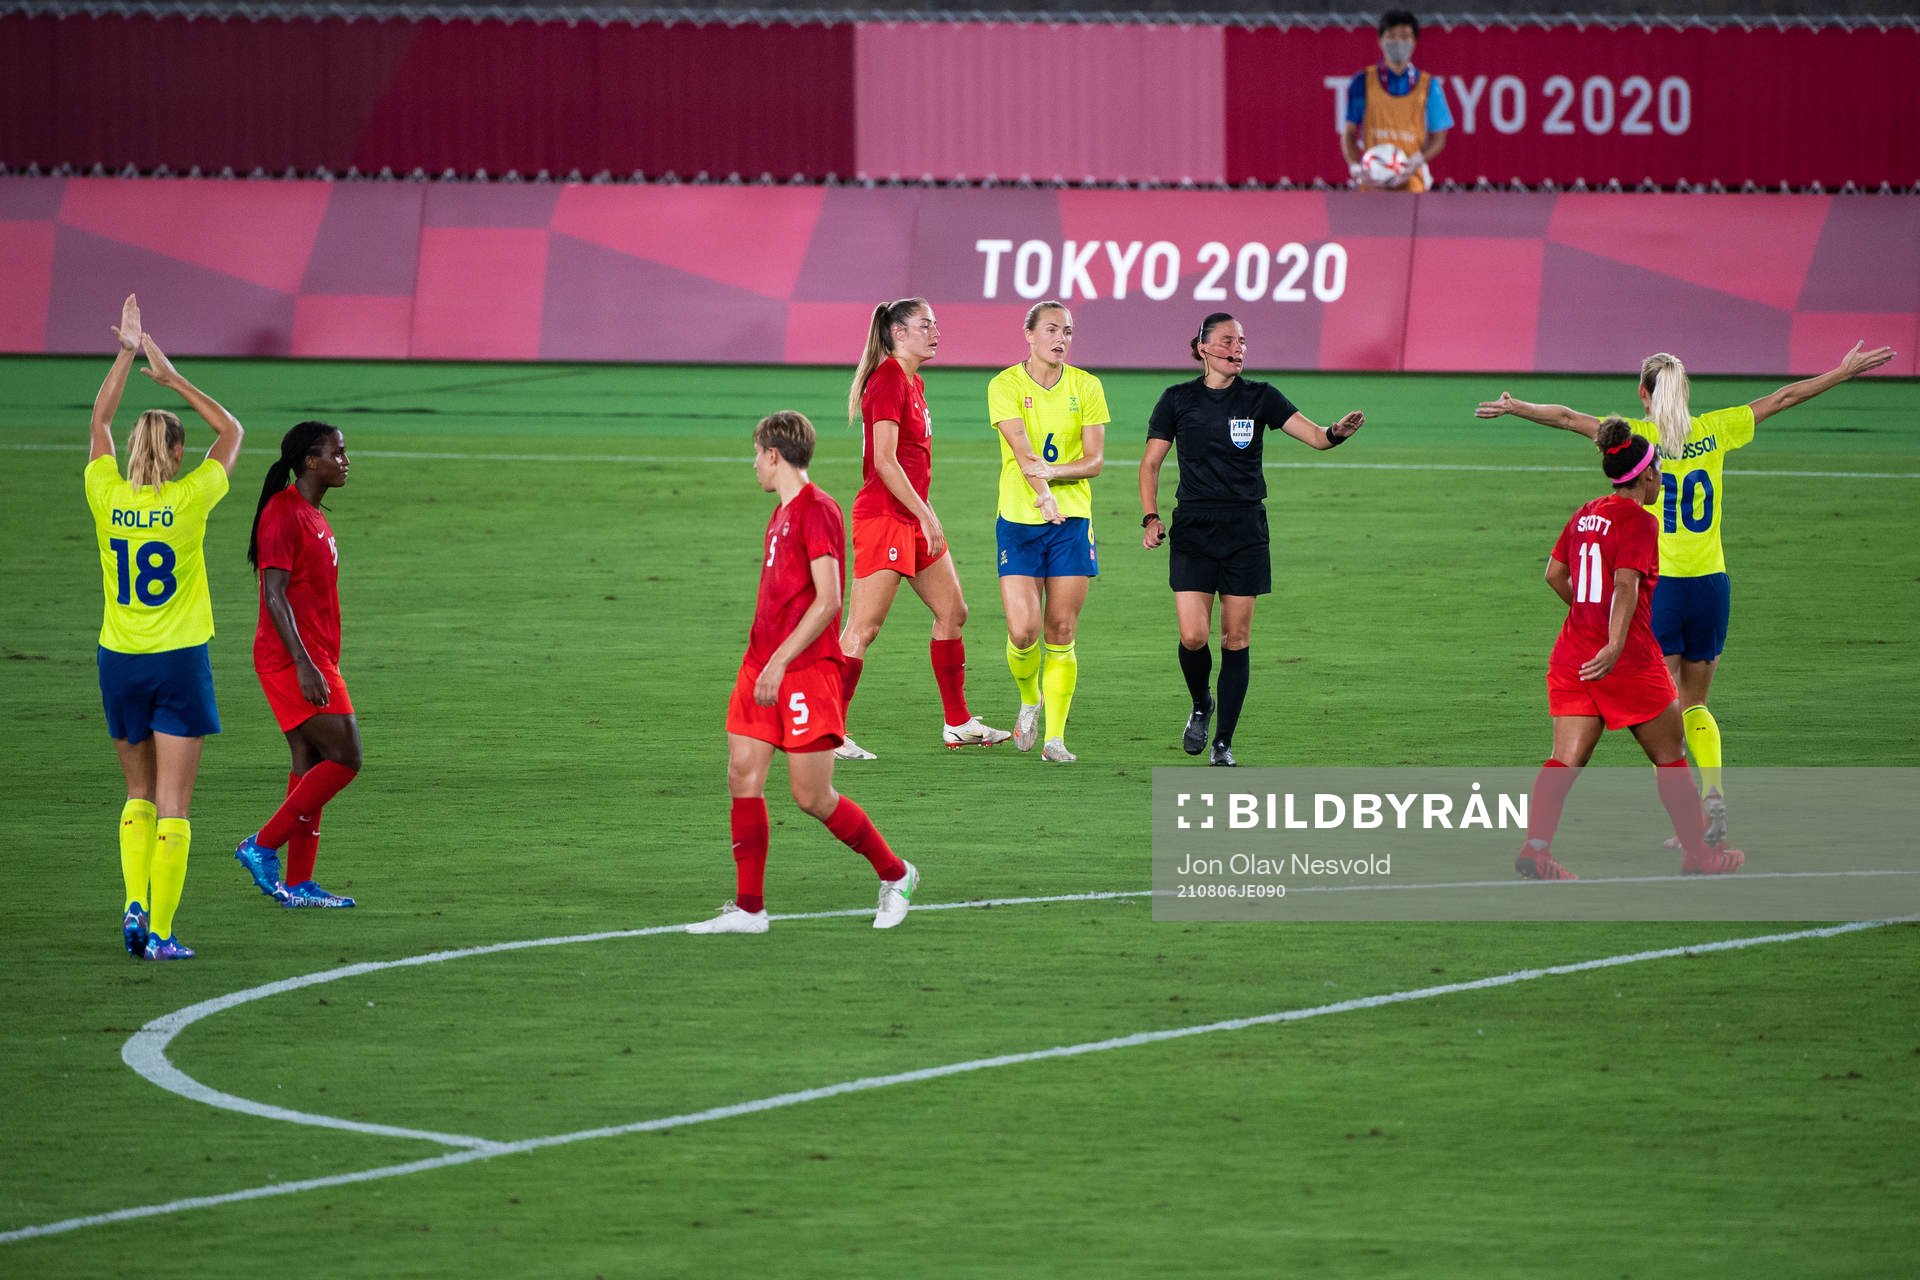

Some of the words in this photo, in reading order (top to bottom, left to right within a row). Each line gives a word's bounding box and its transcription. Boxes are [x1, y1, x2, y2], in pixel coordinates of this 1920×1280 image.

[1323, 75, 1527, 134] TYO
[1542, 75, 1691, 135] 2020
[976, 239, 1180, 300] TOKYO
[1193, 241, 1348, 303] 2020
[1043, 433, 1058, 463] 6
[111, 506, 174, 528] ROLFÖ
[1577, 514, 1612, 536] SCOTT
[1661, 469, 1714, 533] 10
[109, 538, 177, 607] 18
[1577, 542, 1603, 604] 11
[789, 692, 810, 725] 5
